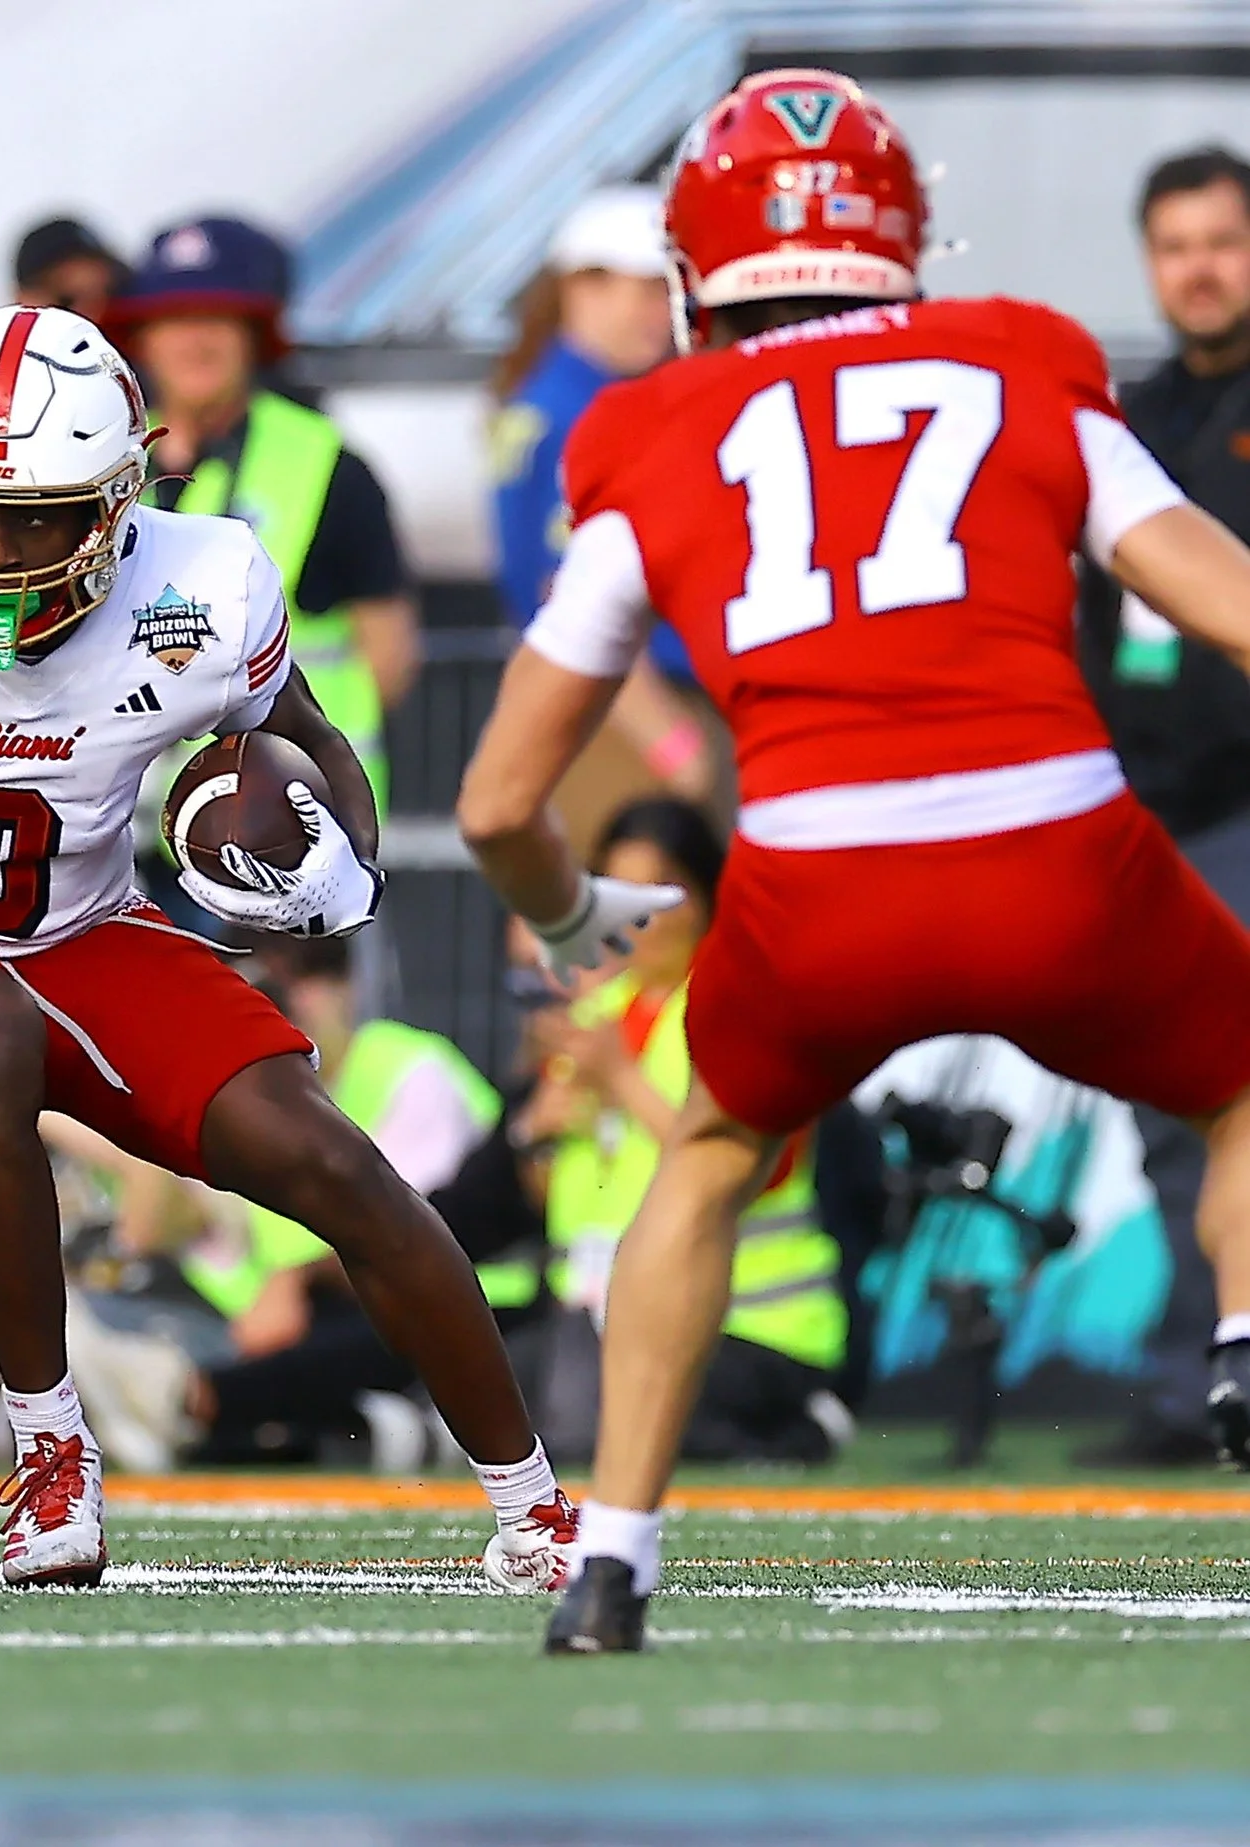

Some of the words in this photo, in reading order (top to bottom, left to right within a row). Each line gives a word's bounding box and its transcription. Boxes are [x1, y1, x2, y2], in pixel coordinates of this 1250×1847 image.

[716, 358, 1004, 656] 17
[138, 617, 209, 637] ARIZONA
[152, 631, 198, 649] BOWL
